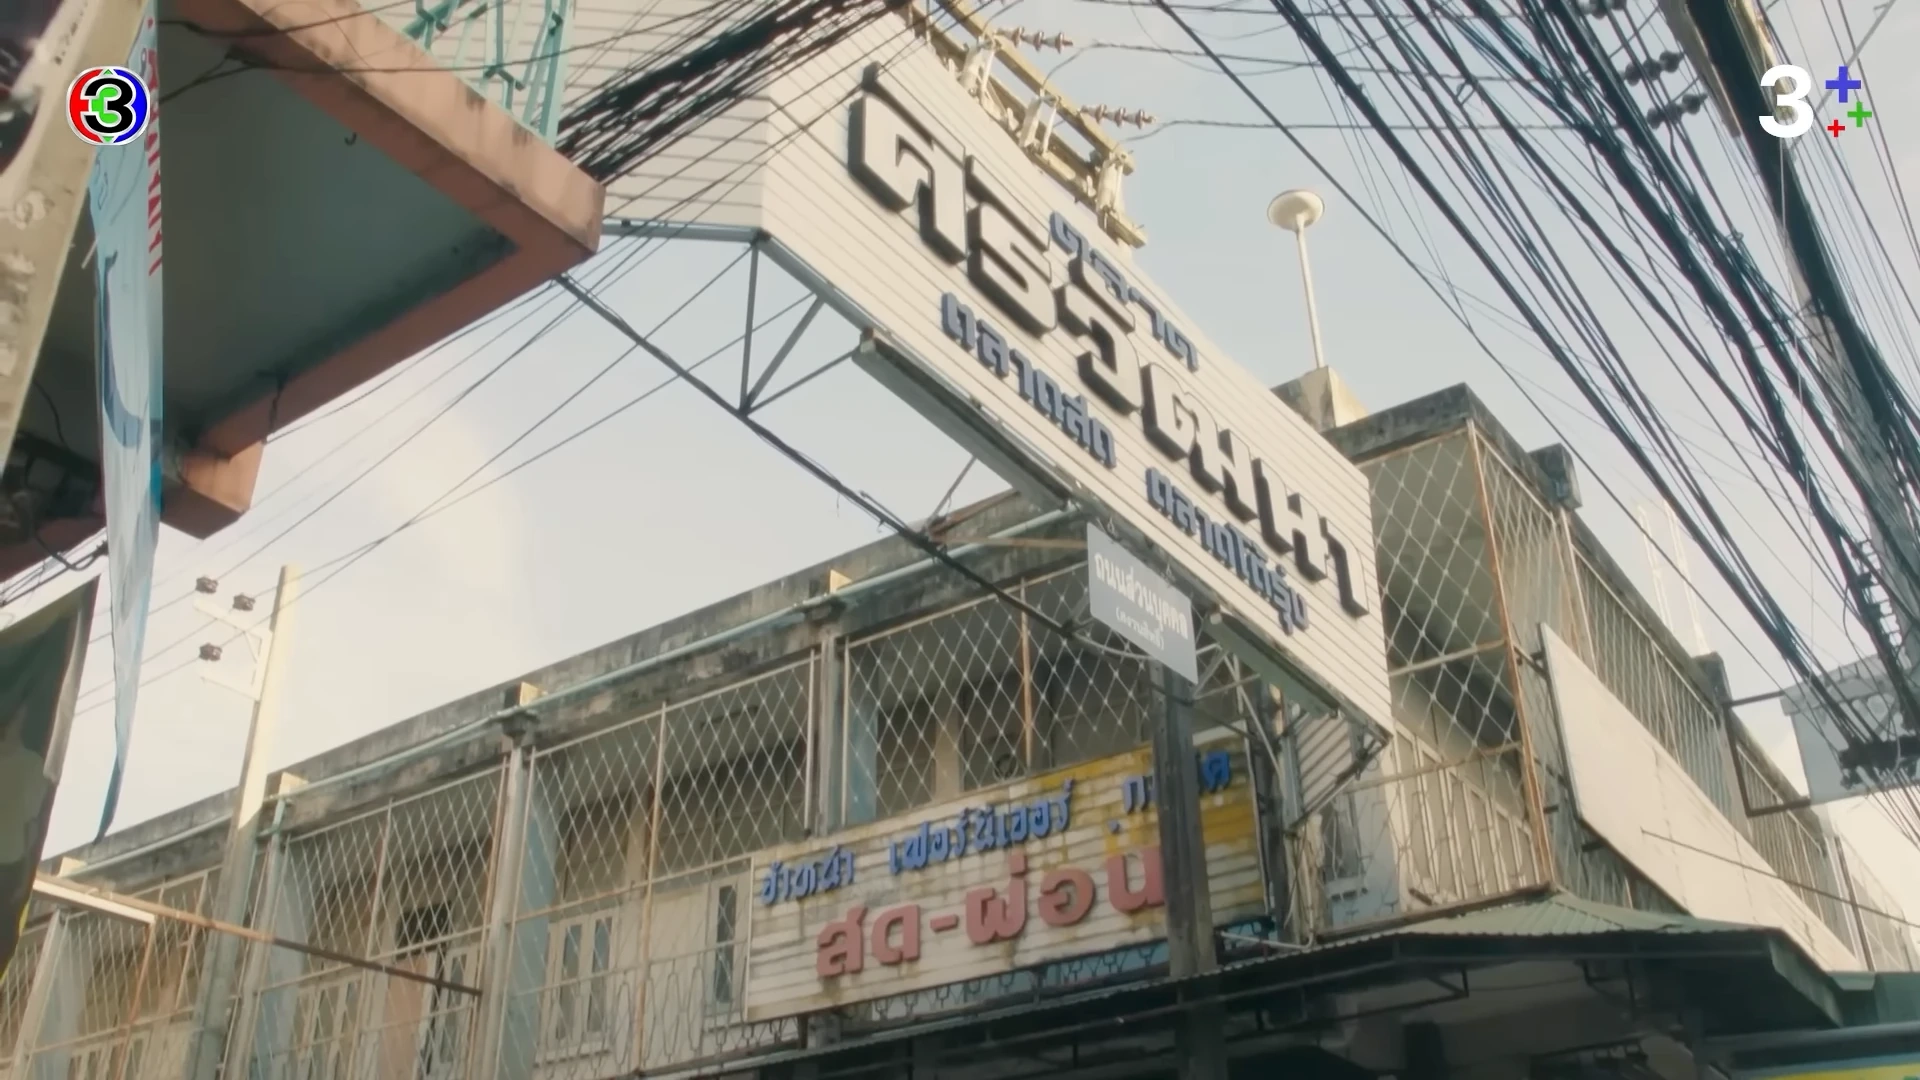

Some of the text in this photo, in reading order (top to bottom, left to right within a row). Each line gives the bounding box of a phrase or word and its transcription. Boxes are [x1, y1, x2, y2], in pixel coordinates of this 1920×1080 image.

[847, 59, 1369, 619] ศรีวัฒนา
[1049, 210, 1199, 373] ตลาด
[941, 292, 1310, 637] ตลาดสด ตลาดโต้รุ่ง
[1093, 552, 1189, 640] ถนนส่วนบุคคล
